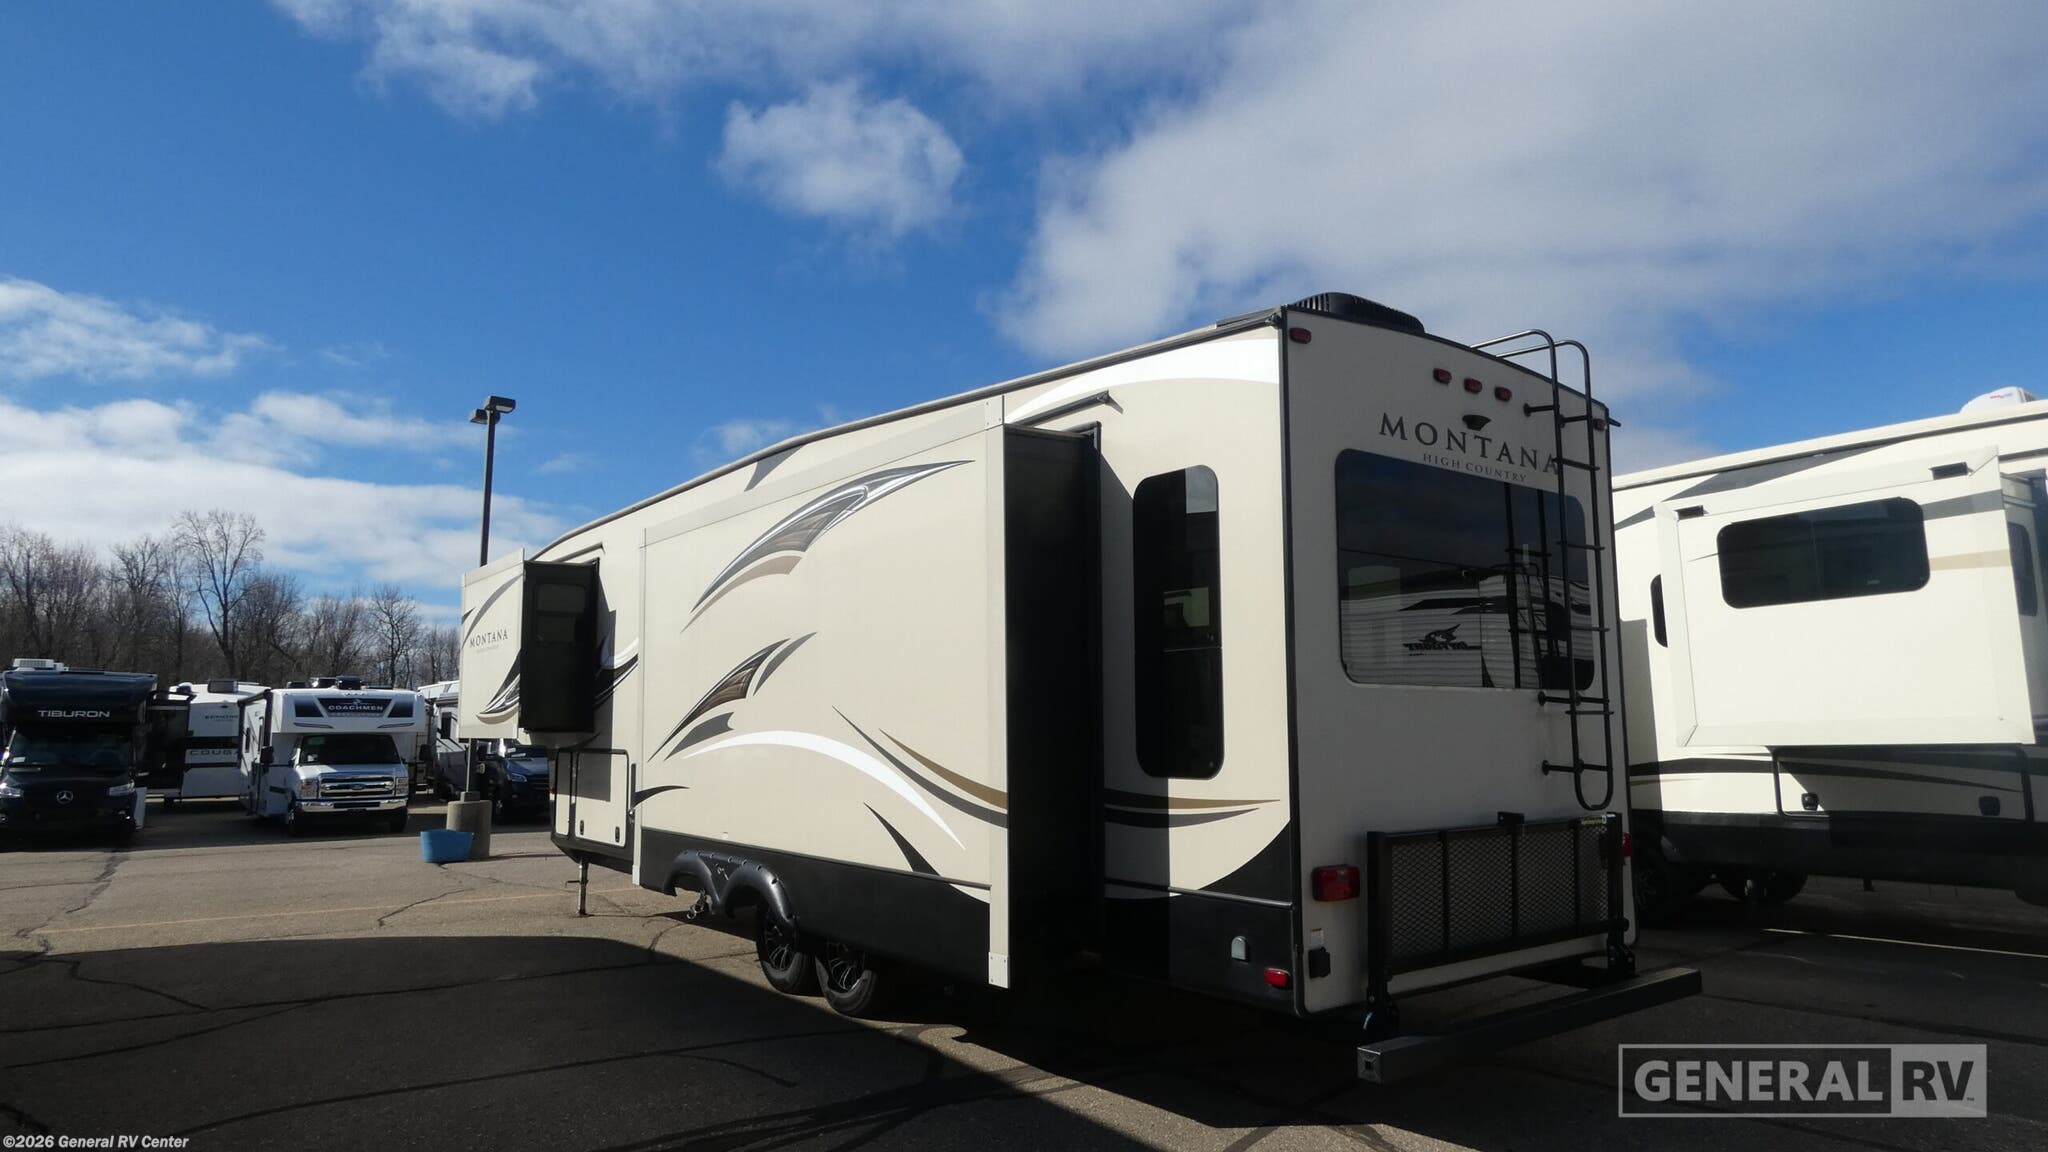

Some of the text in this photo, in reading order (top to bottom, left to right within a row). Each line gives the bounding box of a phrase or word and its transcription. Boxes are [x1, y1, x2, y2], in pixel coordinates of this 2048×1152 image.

[1379, 412, 1559, 476] MONTANA
[1423, 453, 1527, 483] HIGH COUNTRY
[470, 628, 509, 648] MONTANA
[37, 709, 111, 718] TIBURON
